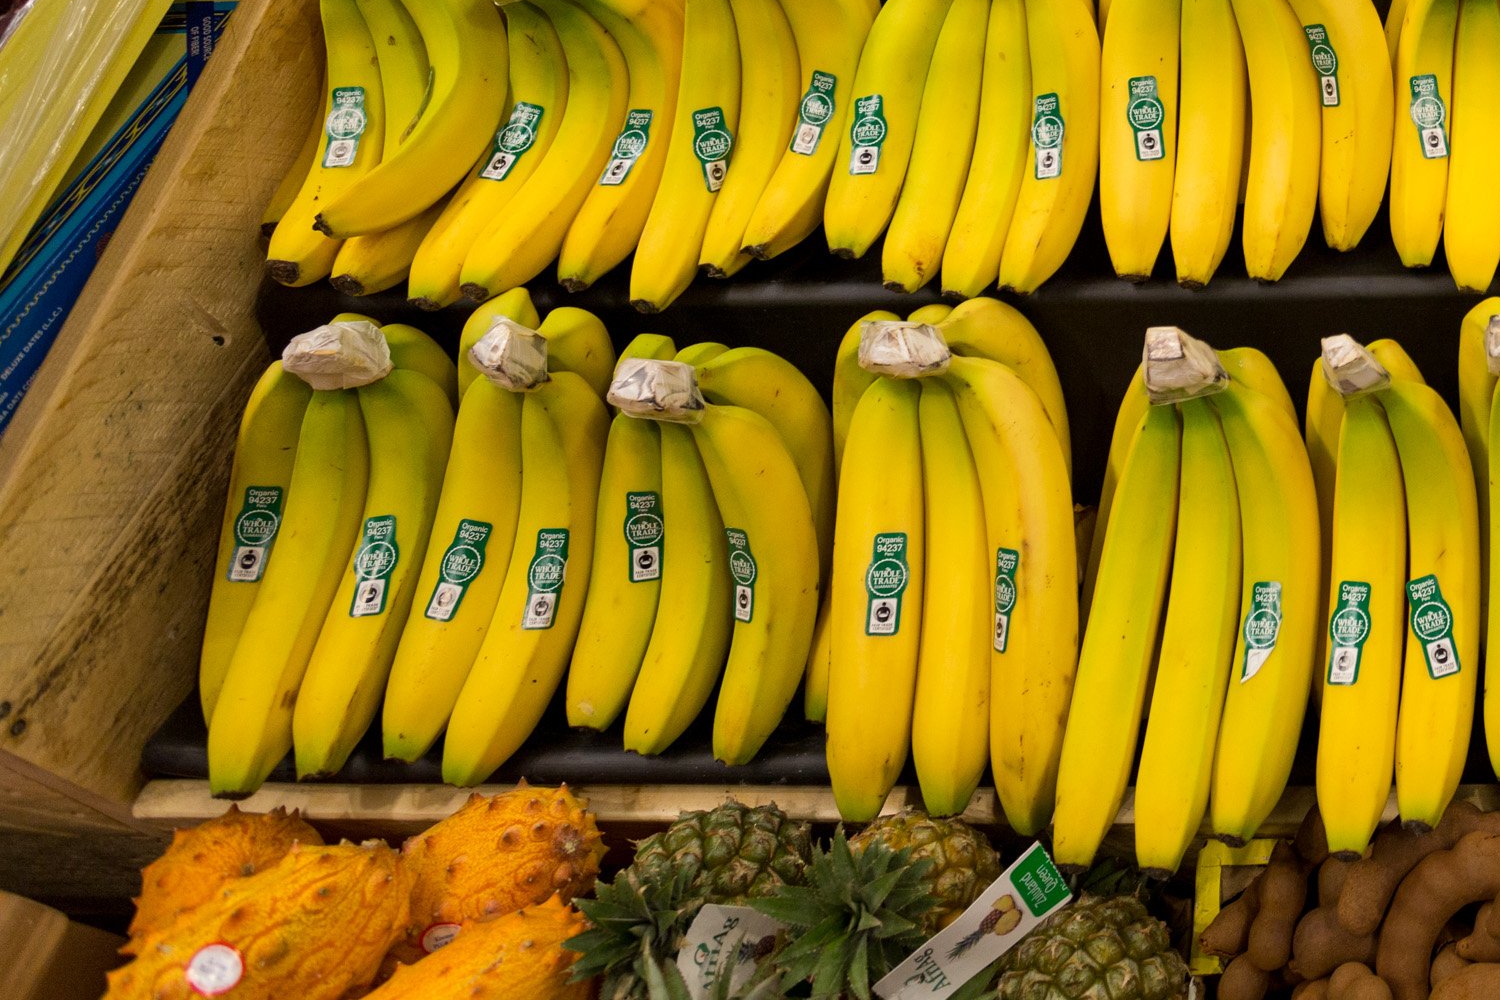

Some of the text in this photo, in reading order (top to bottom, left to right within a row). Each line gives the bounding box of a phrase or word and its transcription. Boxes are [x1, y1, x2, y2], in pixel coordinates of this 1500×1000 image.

[1130, 79, 1154, 87] Organic
[1131, 86, 1154, 94] 94237
[1132, 106, 1157, 115] WHOLE
[1134, 112, 1157, 121] TRADE
[1, 350, 26, 381] DELUXE
[23, 330, 44, 353] DATES
[249, 489, 279, 497] Organic
[248, 496, 278, 504] 94237
[629, 494, 655, 502] Organic
[630, 501, 655, 509] 94237
[243, 519, 273, 528] WHOLE
[630, 522, 658, 531] WHOLE
[243, 527, 271, 535] TRADE
[462, 523, 488, 534] Organic
[632, 529, 659, 537] TRADE
[459, 529, 486, 541] 94237
[540, 532, 566, 540] Organic
[539, 539, 565, 548] 94237
[877, 536, 903, 544] Organic
[877, 543, 903, 552] 94237
[450, 554, 477, 566] WHOLE
[448, 560, 473, 573] TRADE
[535, 565, 563, 573] WHOLE
[535, 572, 561, 580] TRADE
[873, 568, 901, 578] WHOLE
[873, 577, 899, 585] TRADE
[1409, 578, 1435, 592] Organic
[1412, 587, 1436, 600] 94237
[1417, 612, 1444, 625] WHOLE
[1420, 620, 1445, 631] TRADE
[1036, 864, 1059, 894] Queen
[1019, 872, 1047, 908] Zululand
[914, 948, 952, 992] AfriAg
